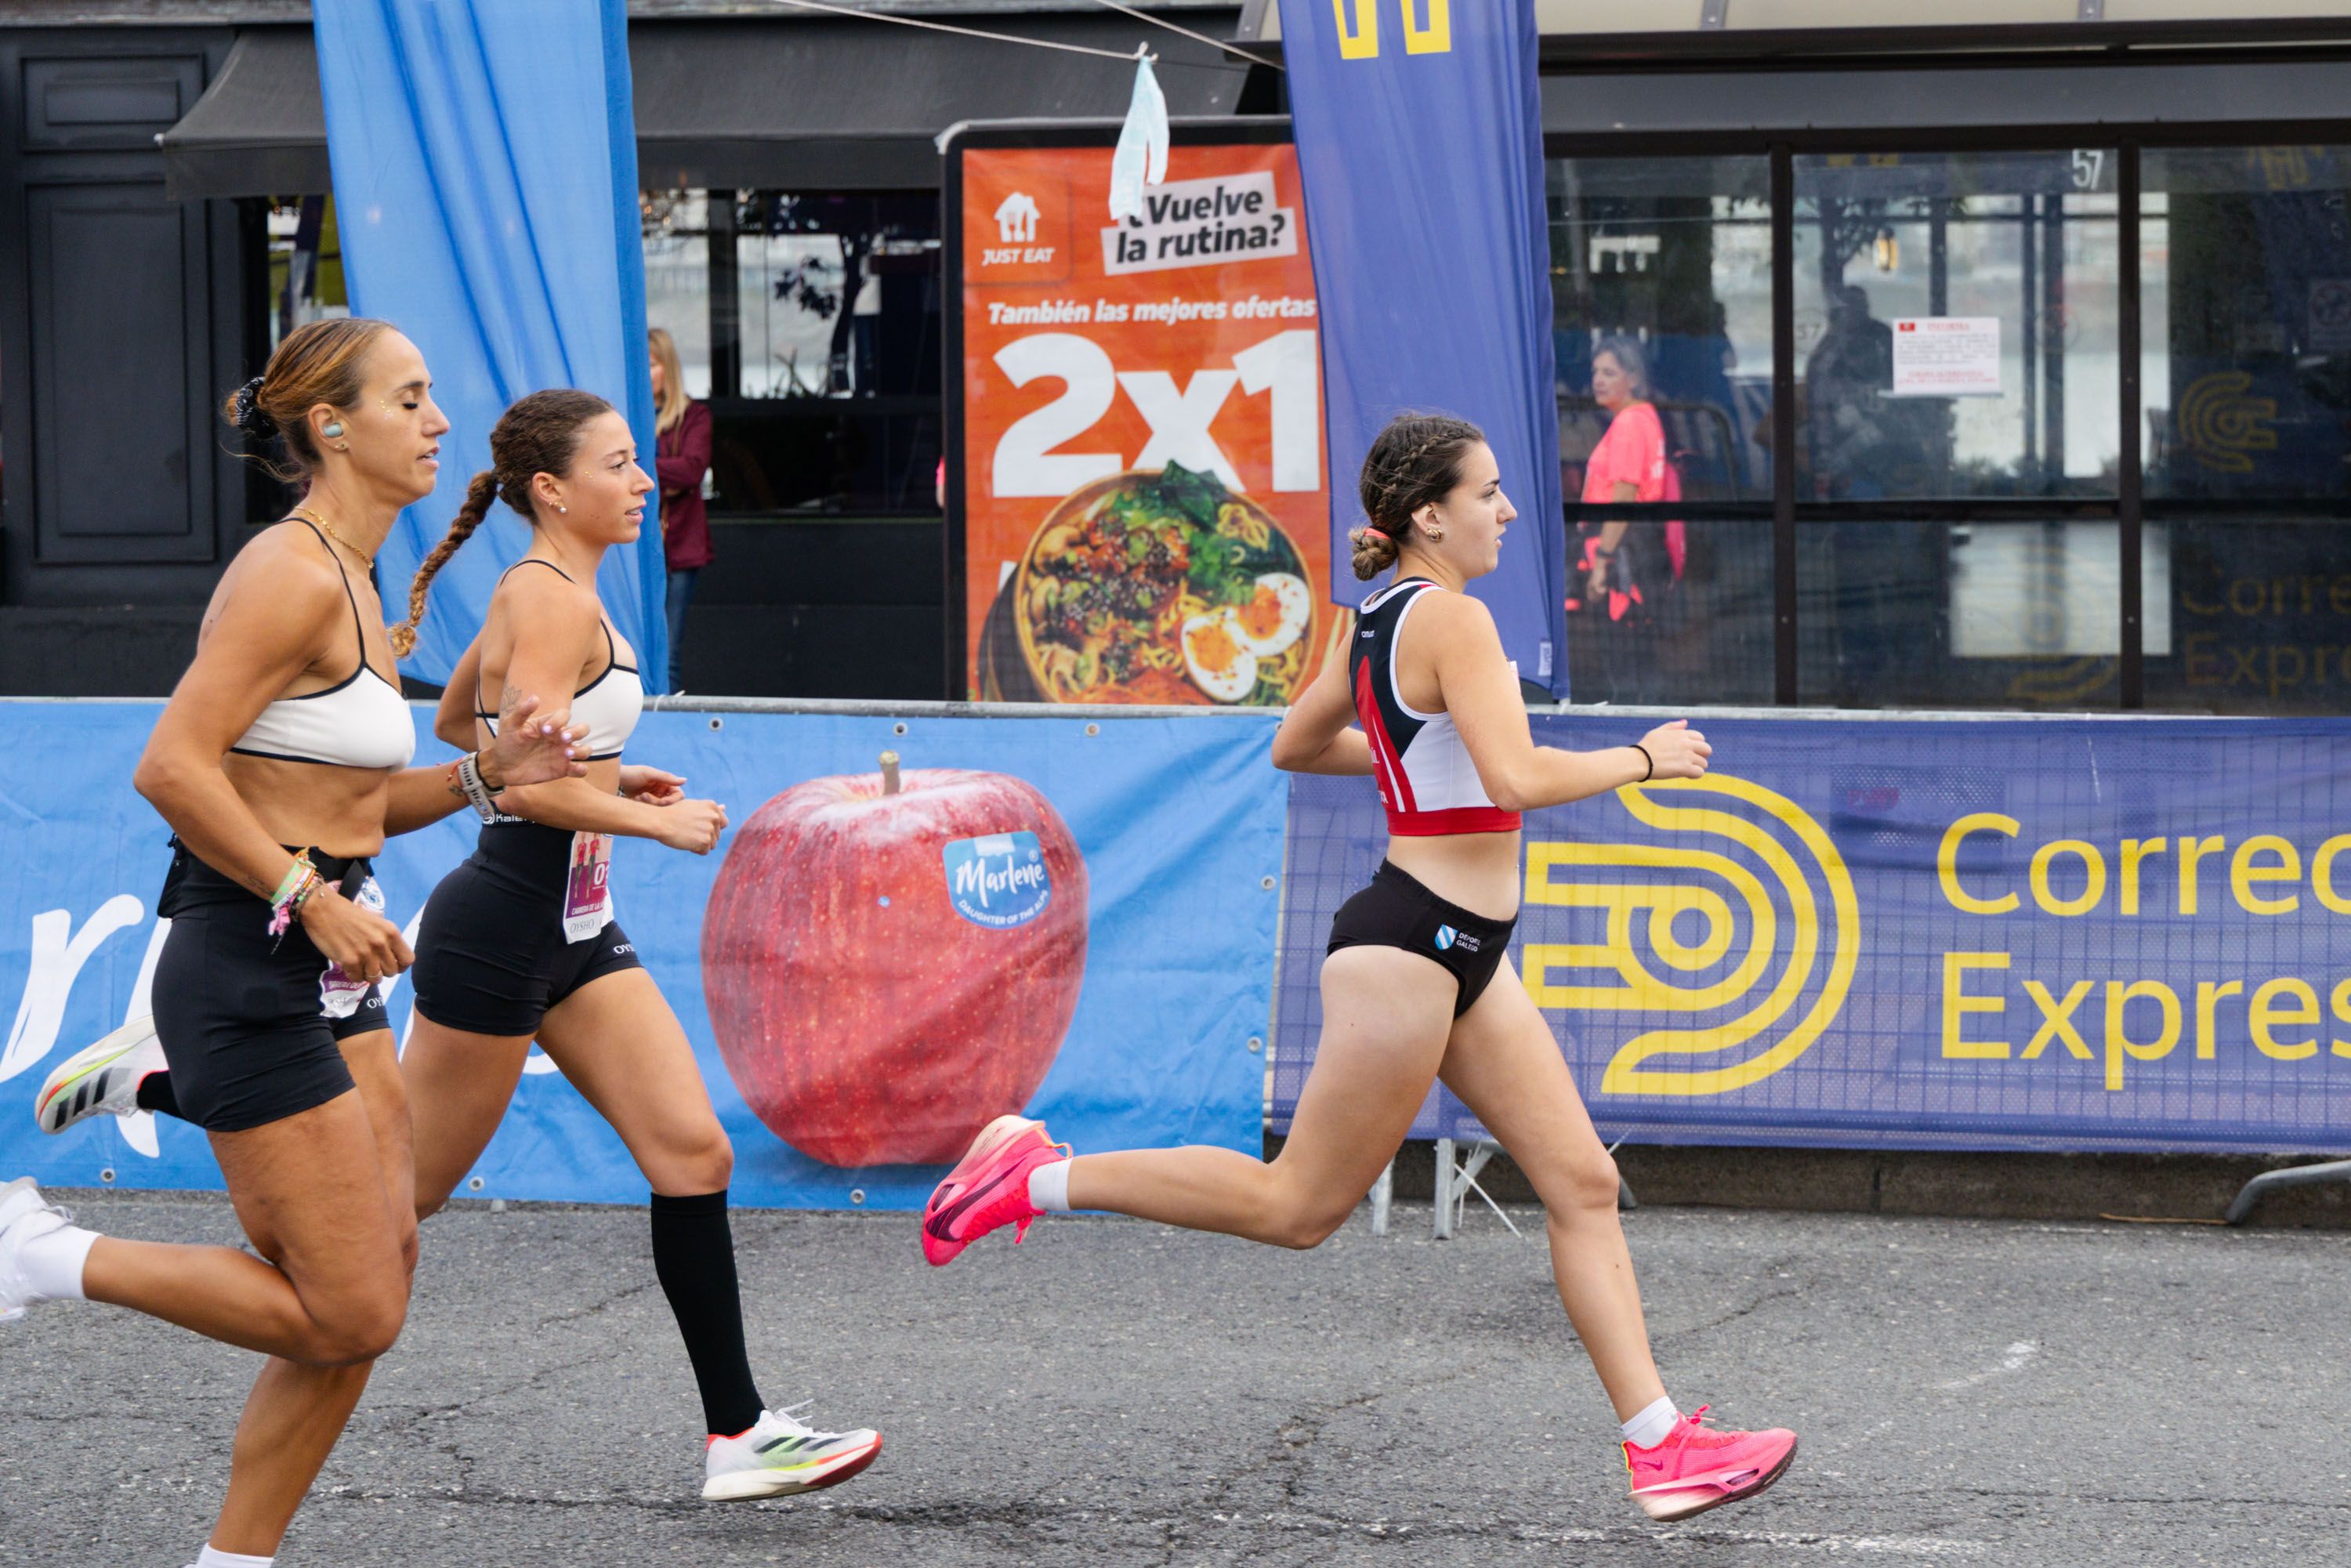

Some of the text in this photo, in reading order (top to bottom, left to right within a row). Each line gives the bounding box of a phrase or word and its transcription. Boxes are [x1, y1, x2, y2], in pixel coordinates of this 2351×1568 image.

[2071, 148, 2104, 190] 57
[1116, 213, 1286, 263] la rutina?
[981, 247, 1056, 266] JUST EAT
[988, 295, 1317, 326] También las mejores ofertas
[992, 329, 1320, 498] 2x1
[956, 855, 1045, 908] Marlene
[958, 889, 1049, 925] DAUGHTER OF THE ALPS
[570, 918, 595, 933] OYSHO
[1456, 940, 1479, 952] GALEGO
